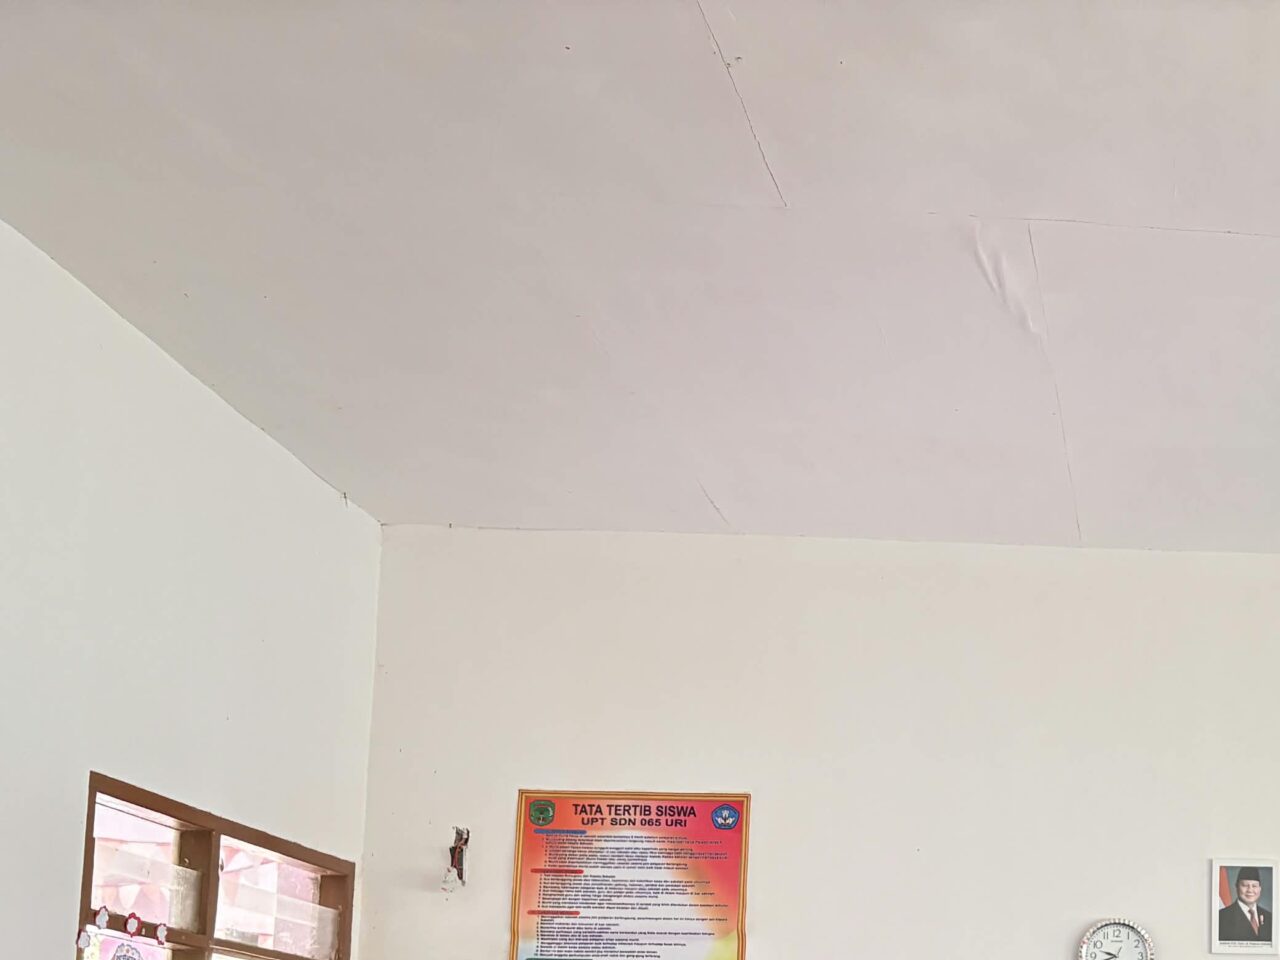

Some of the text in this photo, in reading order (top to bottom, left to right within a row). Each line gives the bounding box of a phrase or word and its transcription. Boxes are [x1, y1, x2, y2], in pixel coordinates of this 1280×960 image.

[571, 803, 697, 818] TATA TERTIB SISWA
[581, 817, 688, 828] UPT SDN 065 URI
[1112, 928, 1121, 938] 12
[1093, 940, 1103, 949] 10
[1134, 939, 1141, 948] 2
[1090, 951, 1097, 960] 9
[1137, 951, 1144, 960] 3
